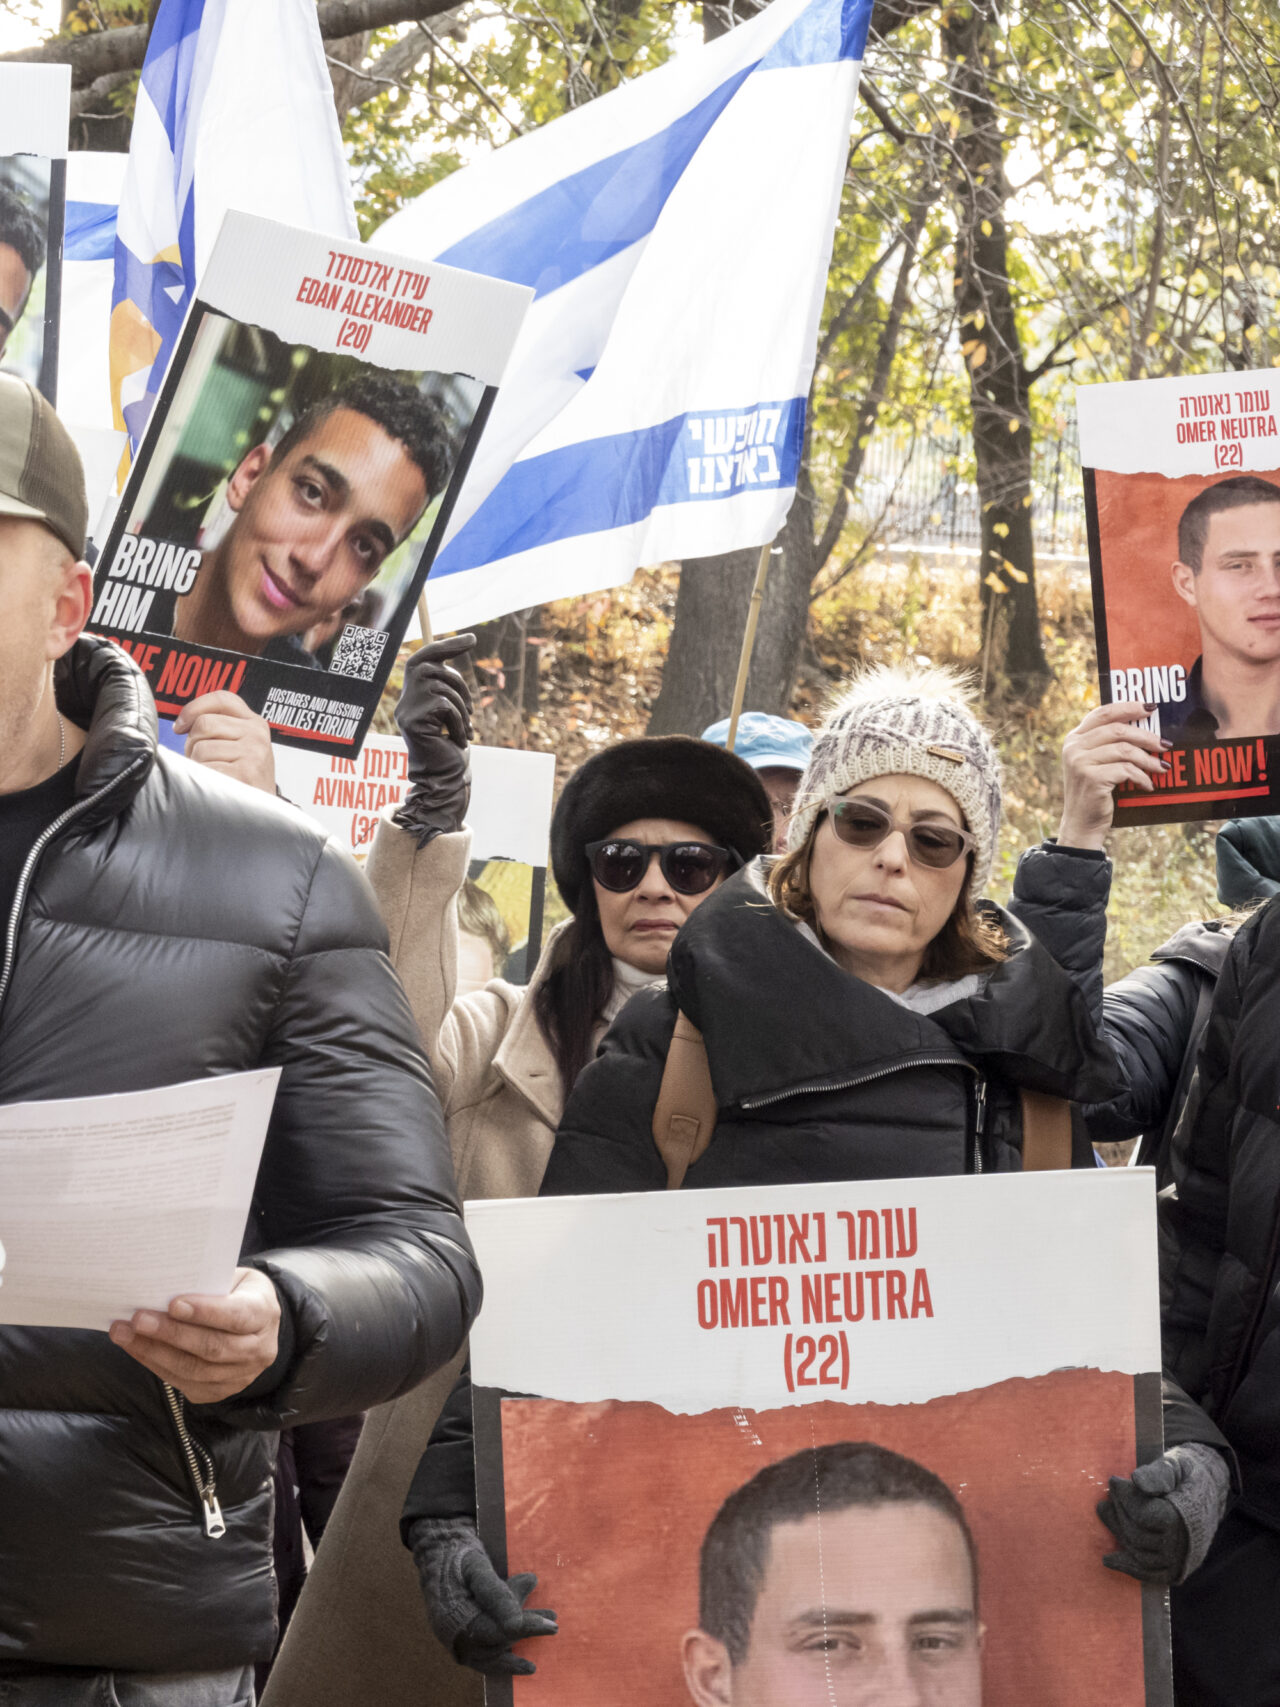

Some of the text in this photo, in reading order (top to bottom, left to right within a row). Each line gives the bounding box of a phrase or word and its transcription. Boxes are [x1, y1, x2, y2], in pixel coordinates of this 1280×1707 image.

[326, 251, 431, 301] עידן אלכסנדר
[296, 276, 433, 334] EDAN ALEXANDER
[336, 318, 373, 353] (20)
[1179, 389, 1270, 418] עומר נאוטרה
[687, 409, 782, 455] חופשי
[1176, 415, 1278, 444] OMER NEUTRA
[687, 445, 781, 494] בארצנו
[1214, 442, 1243, 469] (22)
[108, 534, 202, 593] BRING
[91, 580, 156, 634] HIM
[267, 687, 365, 720] HOSTAGES AND MISSING
[1110, 664, 1187, 704] BRING
[261, 702, 360, 740] FAMILIES FORUM
[1194, 739, 1268, 786] NOW!
[313, 777, 400, 811] AVINATAN
[706, 1207, 918, 1268] עומר נאוטרה
[697, 1268, 934, 1330] OMER NEUTRA
[783, 1330, 850, 1393] (22)
